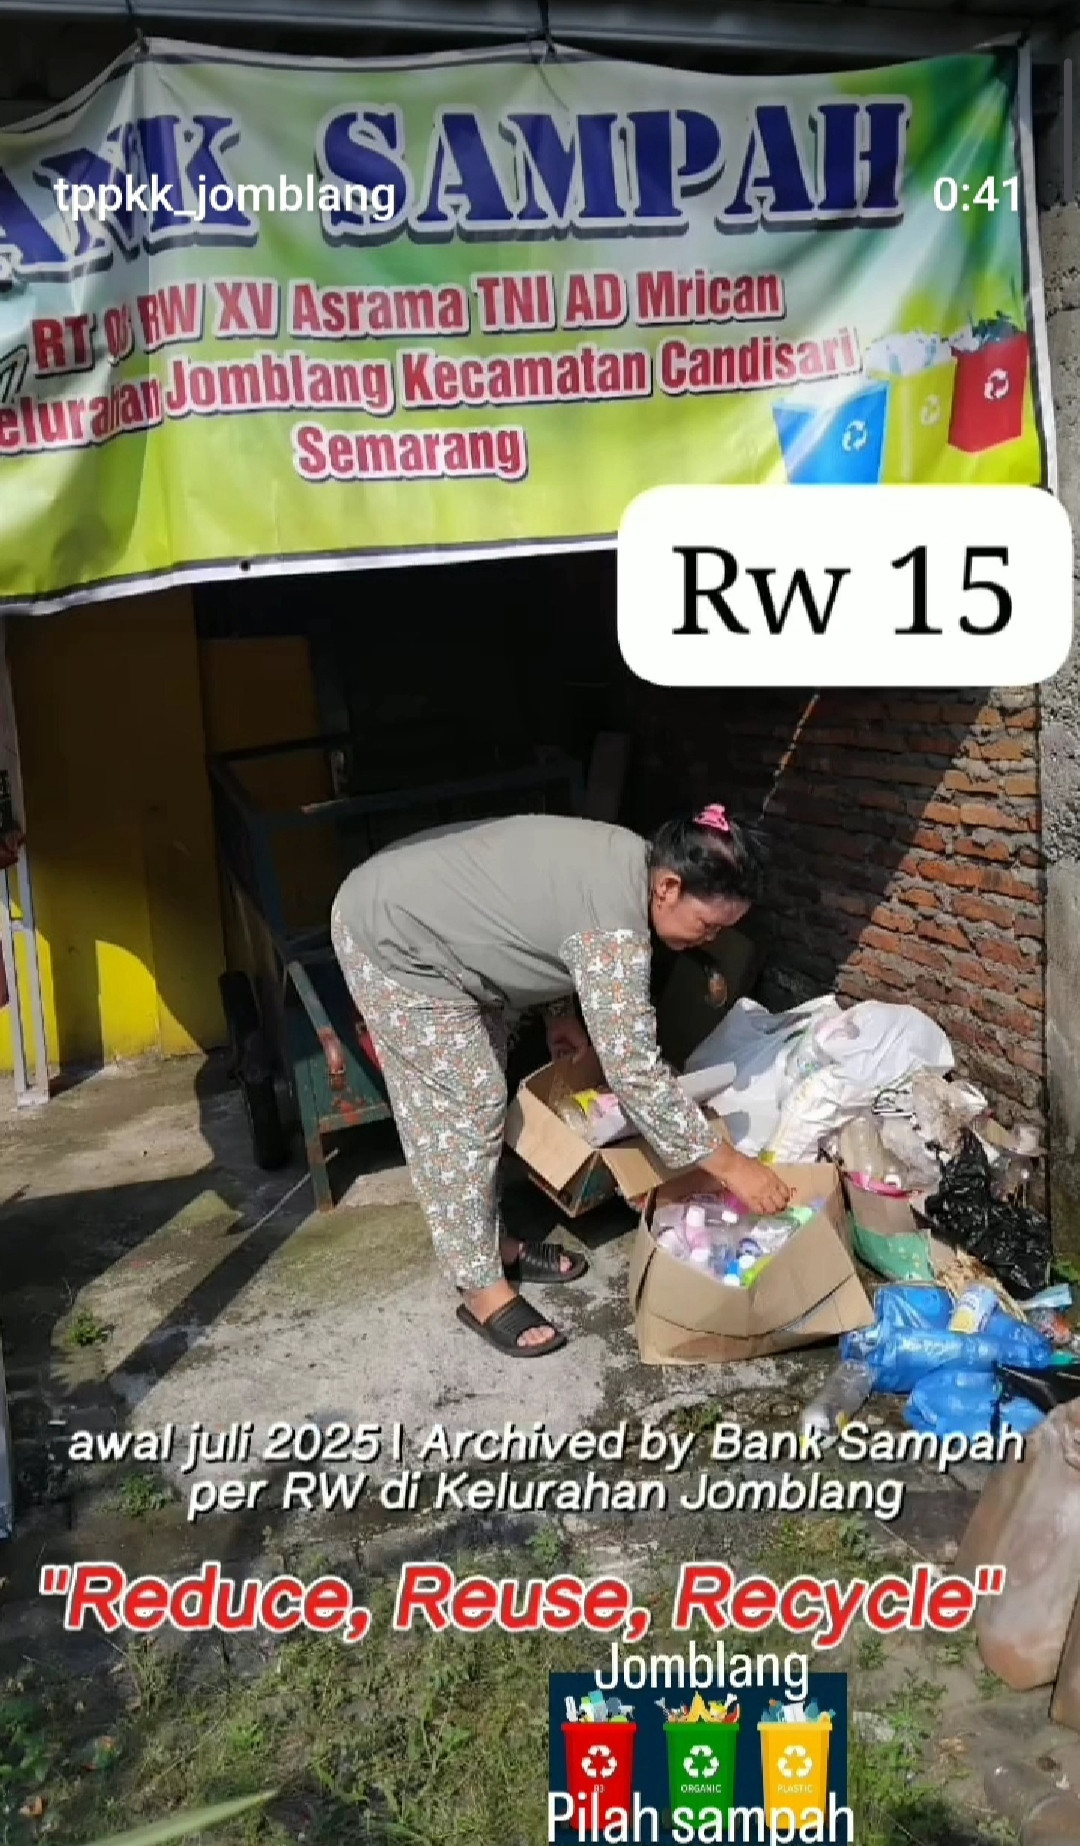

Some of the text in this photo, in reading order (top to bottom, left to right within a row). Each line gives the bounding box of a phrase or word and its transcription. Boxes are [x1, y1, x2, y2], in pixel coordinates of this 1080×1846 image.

[320, 101, 911, 236] SAMPAH
[32, 313, 92, 371] RT
[136, 281, 200, 348] RW
[213, 281, 277, 334] XV
[290, 282, 466, 336] Asrama
[478, 276, 555, 329] TNI
[566, 272, 626, 324] AD
[636, 270, 783, 322] Mrican
[166, 355, 391, 415] Jomblang
[402, 347, 651, 406] Kecamatan
[661, 330, 861, 393] Candisari
[296, 426, 526, 480] Semarang
